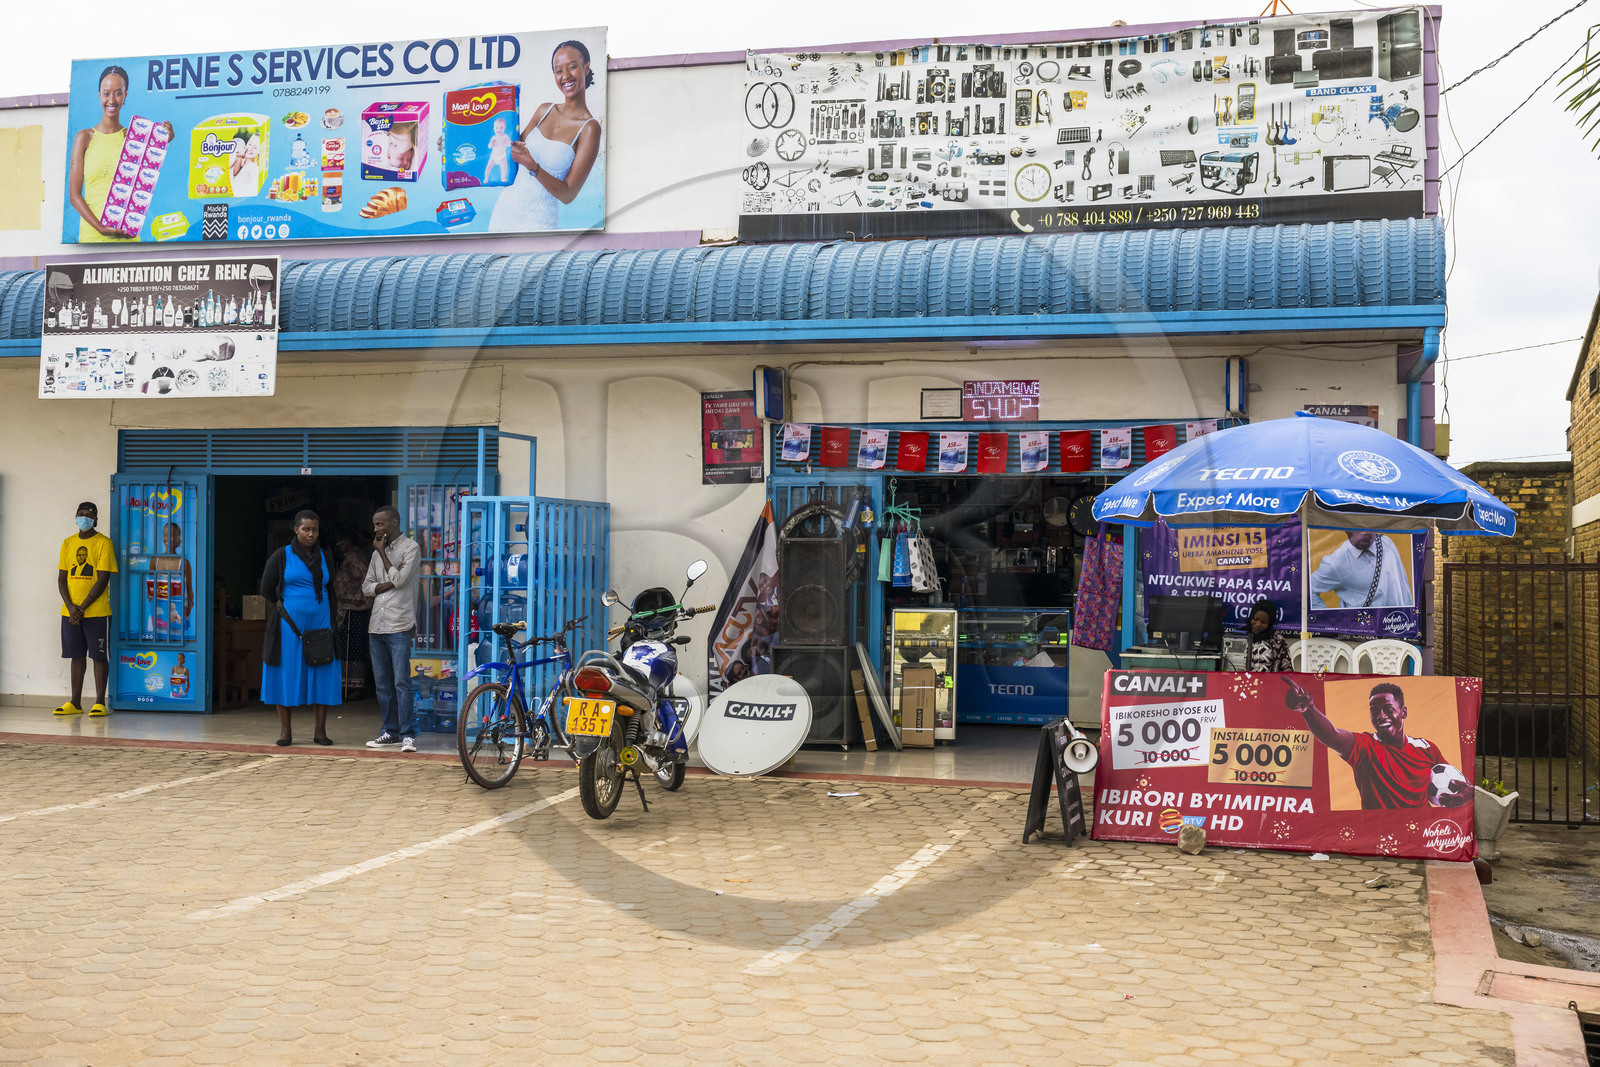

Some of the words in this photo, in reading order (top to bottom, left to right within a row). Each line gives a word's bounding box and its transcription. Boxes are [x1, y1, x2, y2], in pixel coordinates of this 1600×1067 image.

[147, 55, 220, 91] RENE
[227, 53, 243, 86] S
[250, 43, 394, 85] SERVICES
[403, 39, 459, 75] CO
[469, 35, 521, 70] LTD
[273, 86, 331, 97] 0788249199
[1310, 88, 1337, 96] BAND
[1339, 85, 1372, 94] GLAXX
[452, 102, 470, 111] Mami
[472, 102, 489, 112] Love
[369, 118, 385, 126] Best
[203, 142, 234, 155] Bonjour
[204, 211, 227, 219] Rwanda
[238, 214, 291, 224] bonjour_rwanda
[1038, 213, 1053, 227] +0
[1056, 212, 1079, 226] 788
[1082, 211, 1105, 225] 404
[1109, 210, 1132, 224] 889
[1146, 207, 1177, 222] +250
[1181, 206, 1204, 220] 727
[1207, 205, 1231, 219] 969
[1235, 204, 1260, 218] 443
[82, 265, 173, 284] ALIMENTATION
[177, 264, 210, 281] CHEZ
[215, 263, 247, 280] RENE
[972, 398, 1036, 418] SHOP
[1307, 407, 1350, 416] CANAL+
[1199, 467, 1295, 481] TECNO
[1177, 492, 1232, 510] Expect
[1236, 493, 1280, 508] More
[1332, 488, 1391, 504] Expect
[1184, 533, 1240, 549] IMINSI
[1245, 531, 1263, 545] 15
[1206, 548, 1244, 556] AMASHENE
[1217, 557, 1251, 565] CANAL+
[1148, 574, 1215, 588] NTUCIKWE
[1218, 577, 1252, 590] PAPA
[1256, 579, 1291, 592] SAVA
[137, 657, 152, 666] Love
[988, 684, 1034, 695] TECNO
[1114, 675, 1203, 693] CANAL+
[728, 703, 793, 718] CANAL+
[1115, 707, 1170, 720] IBIKORESHO
[1172, 706, 1202, 716] BYOSE
[1204, 705, 1217, 714] KU
[572, 717, 597, 732] 135
[600, 719, 608, 733] T
[1117, 723, 1134, 747] 5
[1141, 717, 1201, 744] 000
[1200, 716, 1217, 724] FRW
[1213, 731, 1290, 743] INSTALLATION
[1294, 733, 1310, 744] KU
[1142, 751, 1161, 763] 10
[1161, 748, 1190, 762] 000
[1212, 743, 1229, 765] 5
[1235, 743, 1292, 767] 000
[1234, 770, 1248, 782] 10
[1250, 770, 1276, 783] 000
[1100, 789, 1184, 808] IBIRORI
[1190, 792, 1314, 814] BY'IMIPIRA
[1099, 809, 1153, 827] KURI
[1184, 817, 1203, 825] RTV
[1210, 814, 1243, 831] HD
[1423, 823, 1452, 838] Noheli
